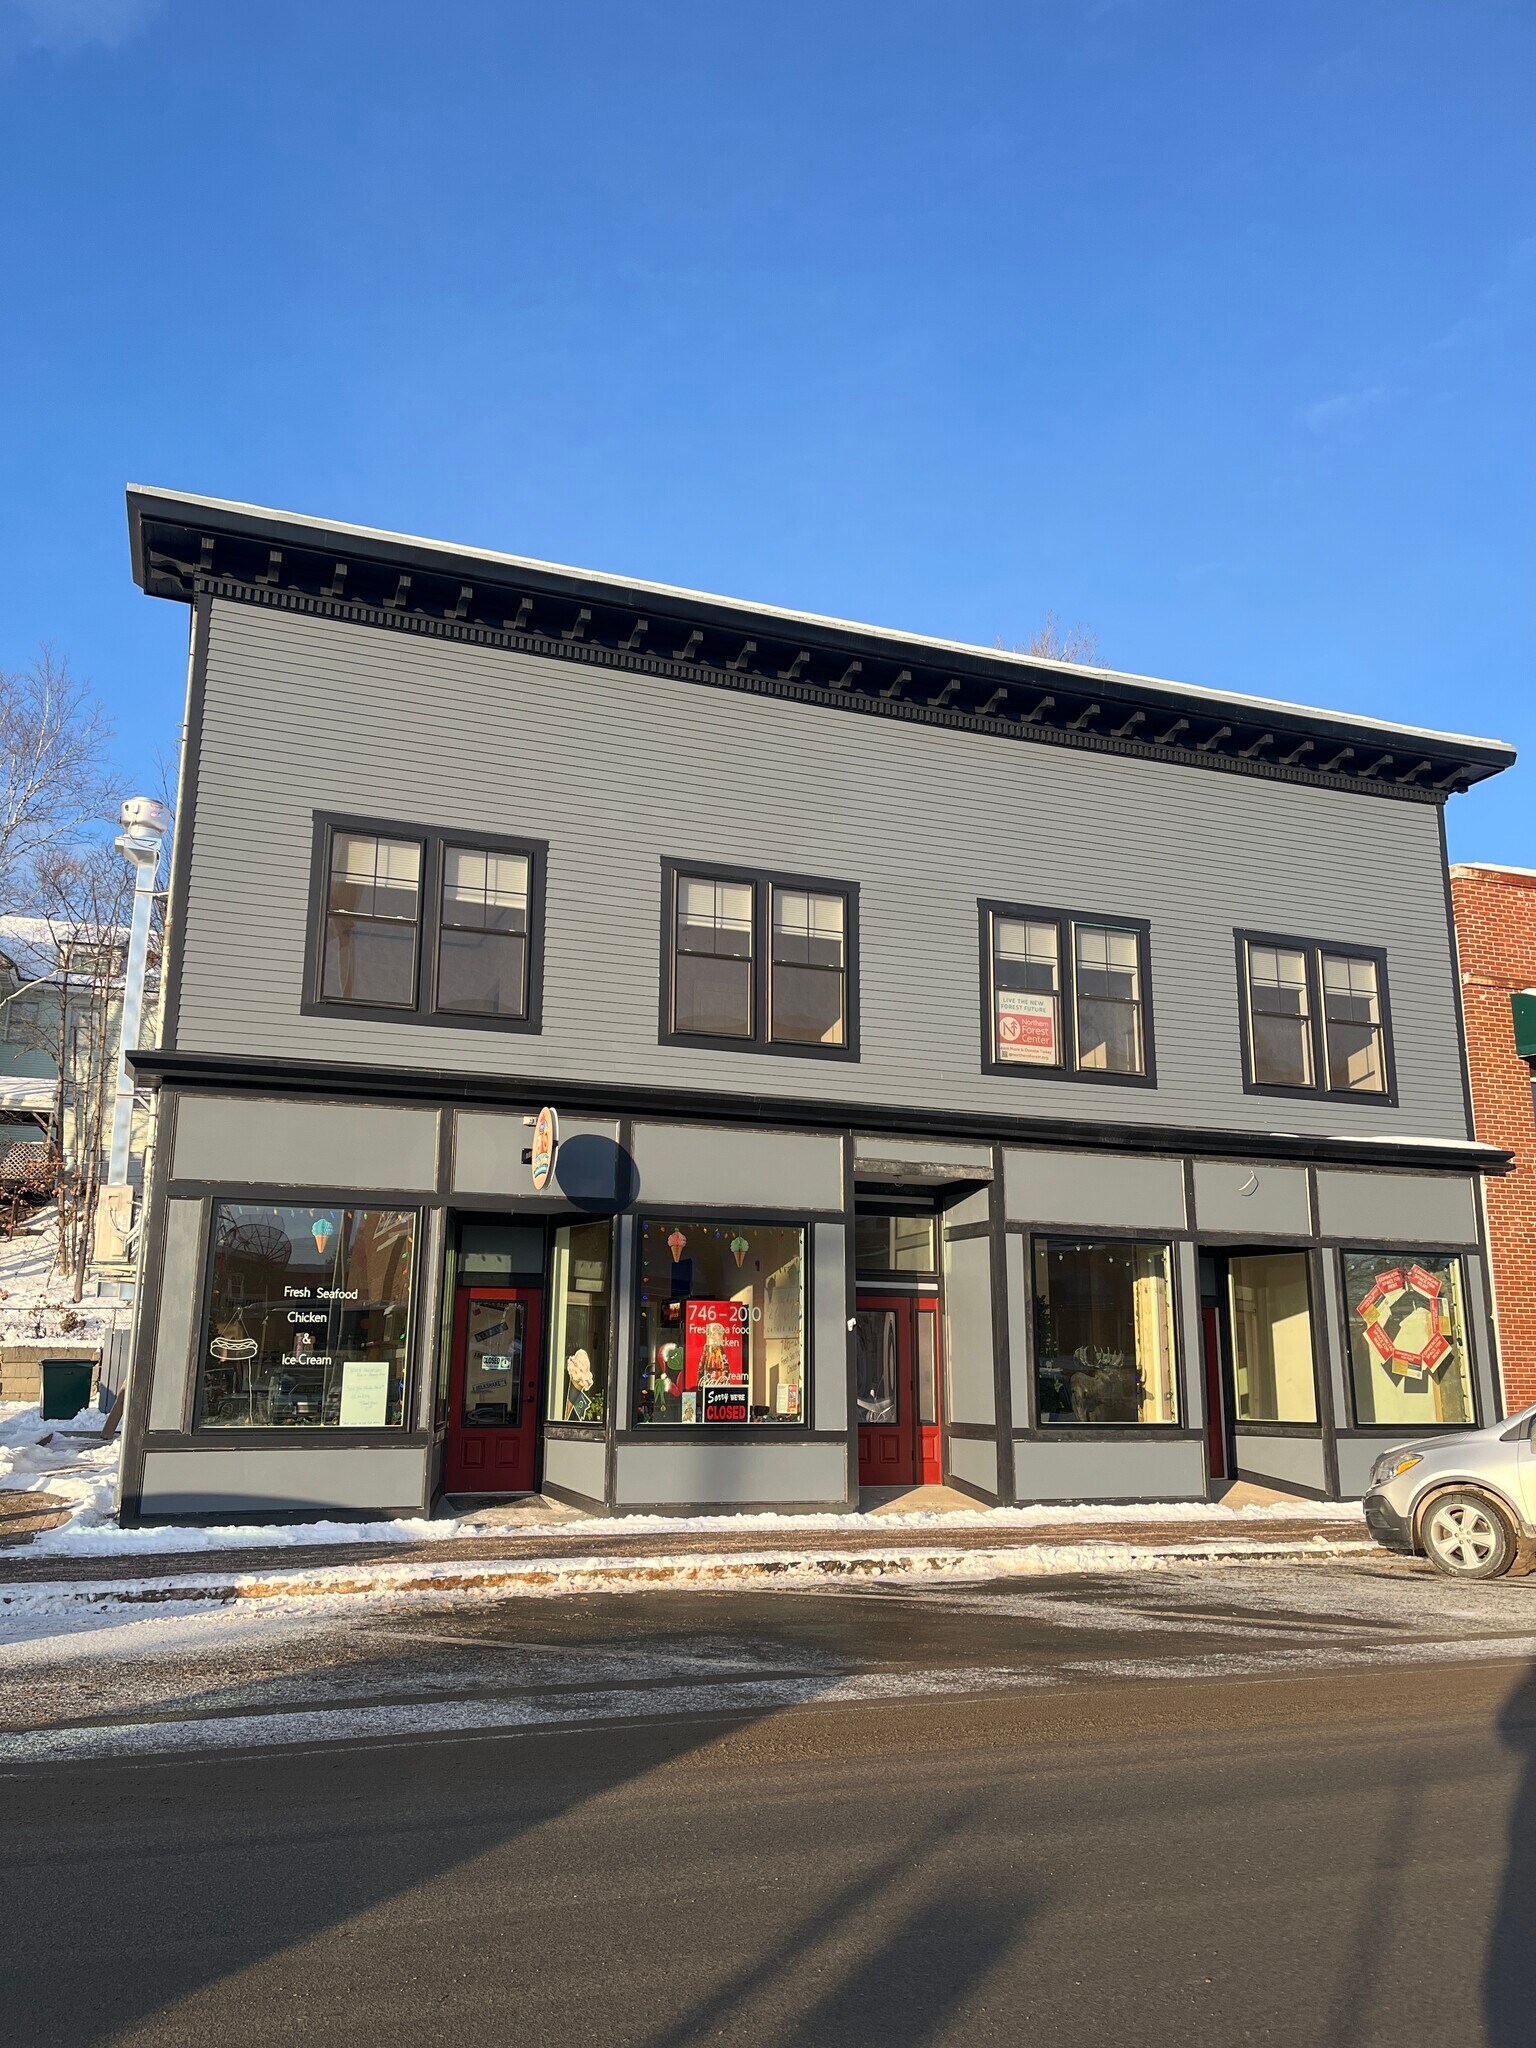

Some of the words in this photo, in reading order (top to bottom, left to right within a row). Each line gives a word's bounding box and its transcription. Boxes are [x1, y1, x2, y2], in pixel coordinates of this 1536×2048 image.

[1024, 1005, 1046, 1013] FUTURE
[1021, 1018, 1049, 1027] Northern
[1021, 1025, 1049, 1036] Forest
[1021, 1034, 1050, 1044] Center
[283, 1286, 311, 1298] Fresh
[316, 1287, 358, 1299] Seafood
[287, 1311, 327, 1322] Chicken
[302, 1333, 312, 1344] &
[282, 1353, 297, 1365] Ice
[298, 1353, 332, 1365] Cream
[722, 1354, 729, 1365] &
[708, 1391, 729, 1404] Sorry
[706, 1405, 746, 1420] CLOSED
